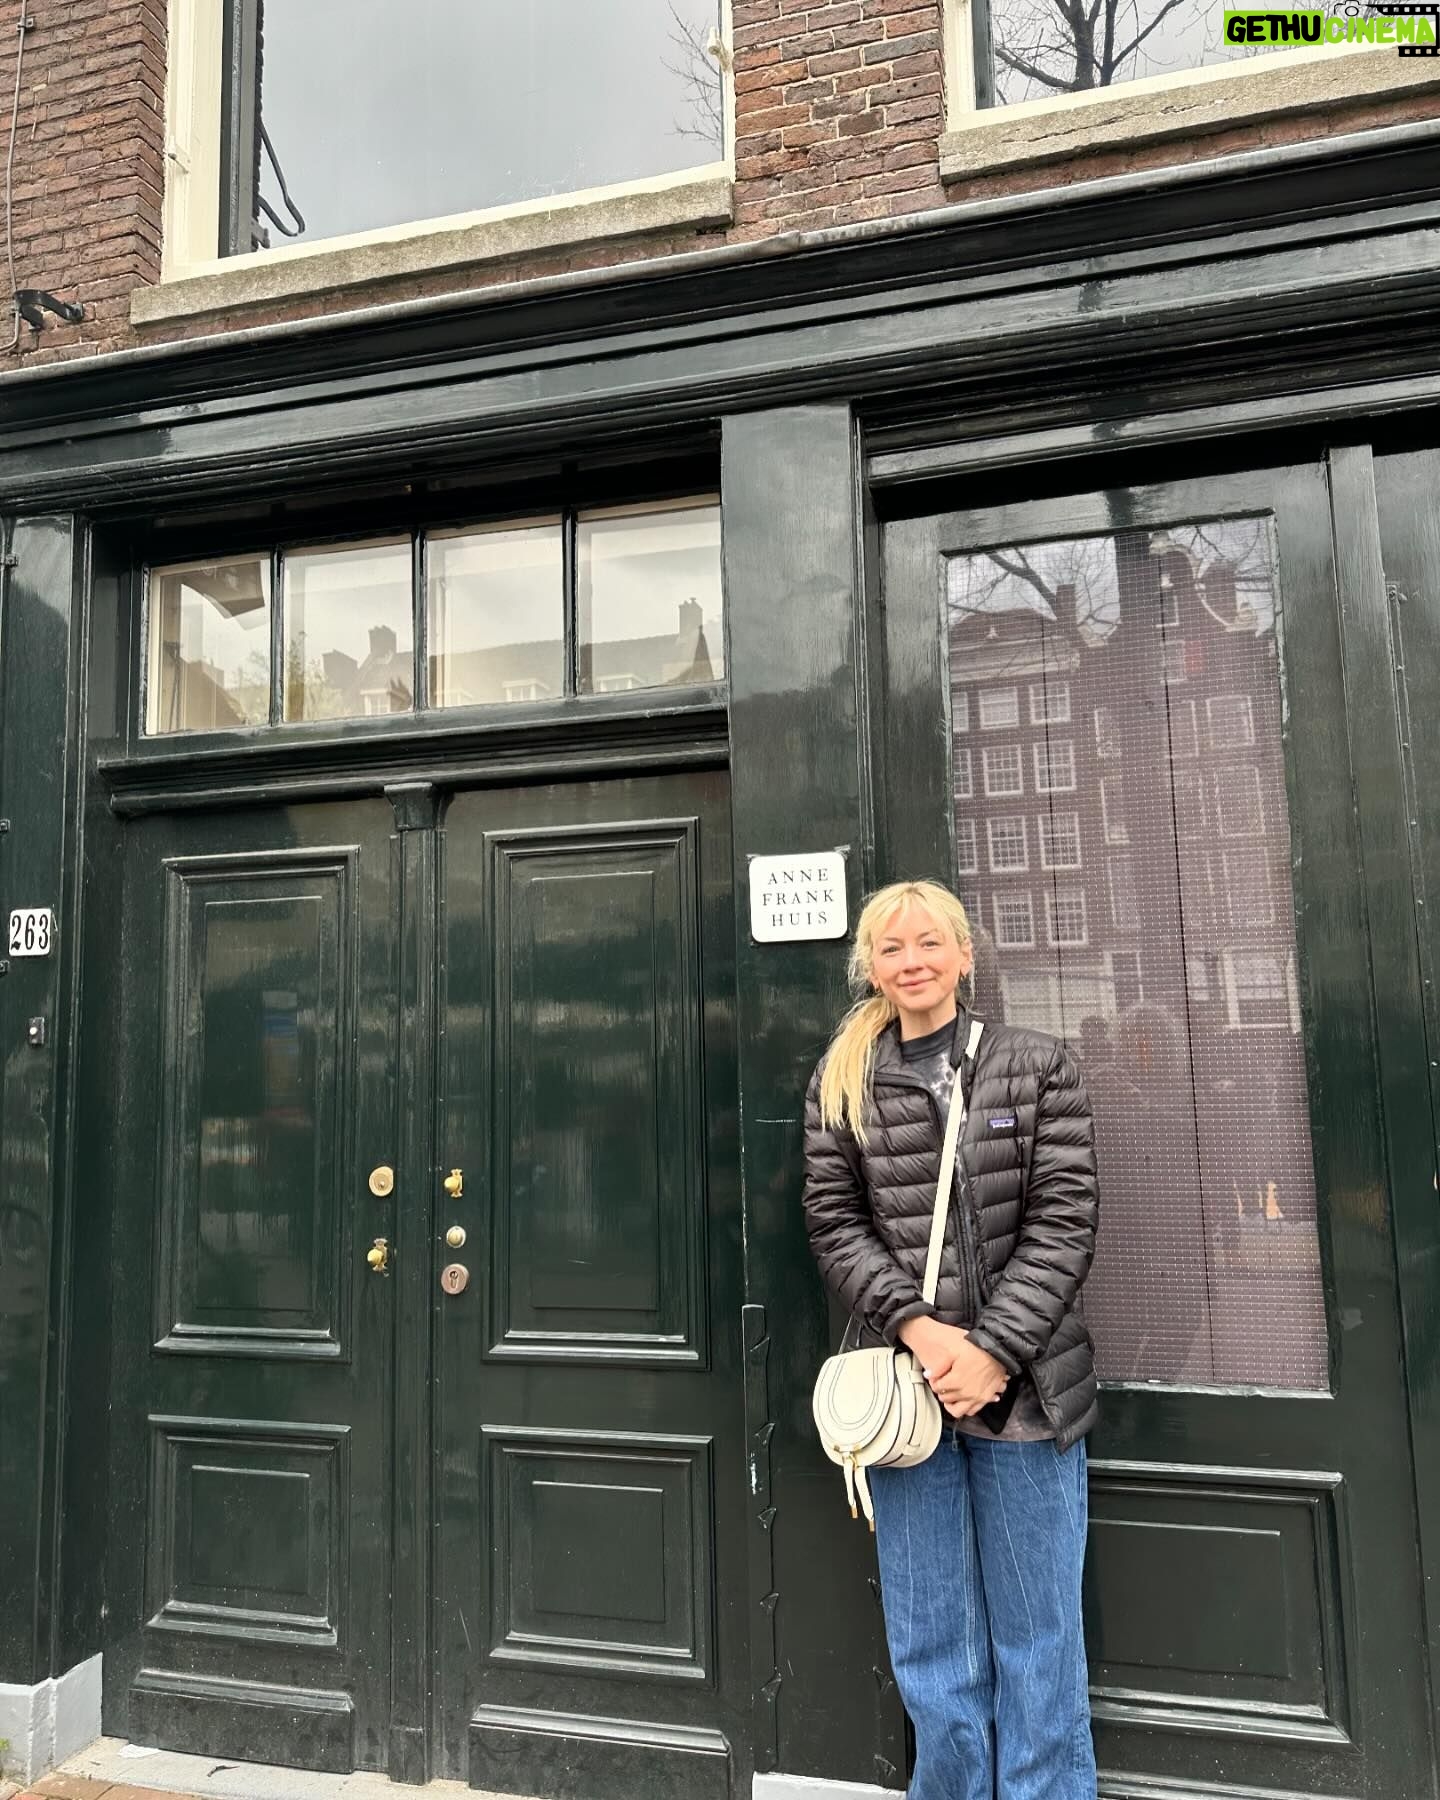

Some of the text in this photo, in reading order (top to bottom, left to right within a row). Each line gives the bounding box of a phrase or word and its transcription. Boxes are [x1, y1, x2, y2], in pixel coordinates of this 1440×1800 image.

[768, 868, 829, 885] ANNE
[762, 889, 834, 906] FRANK
[772, 911, 827, 927] HUIS
[11, 914, 49, 950] 263
